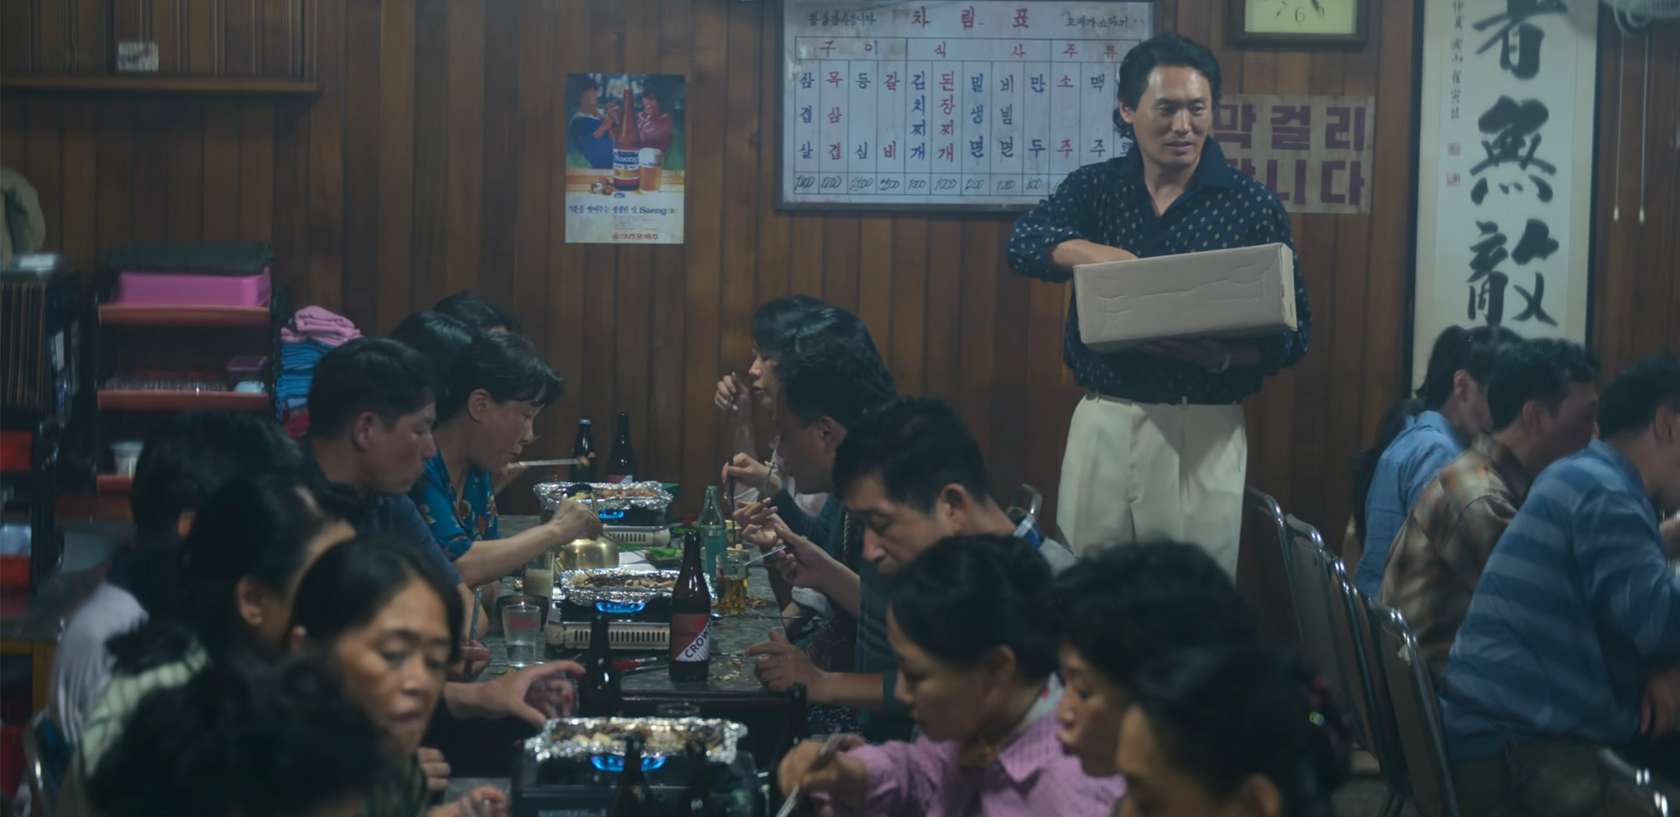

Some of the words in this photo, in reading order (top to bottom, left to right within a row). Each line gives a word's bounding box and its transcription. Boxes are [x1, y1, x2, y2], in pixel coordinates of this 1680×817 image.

[1276, 1, 1288, 17] 7
[1294, 6, 1305, 23] 6
[819, 40, 878, 57] 구이
[1062, 43, 1117, 59] 주류
[799, 72, 815, 159] 삼겹살
[826, 71, 843, 160] 목삼겹
[910, 70, 926, 161] 김치찌개
[937, 70, 956, 162] 된장찌개
[1212, 104, 1366, 152] 막걸리
[1225, 158, 1365, 205] 니다
[639, 205, 667, 216] Saeng
